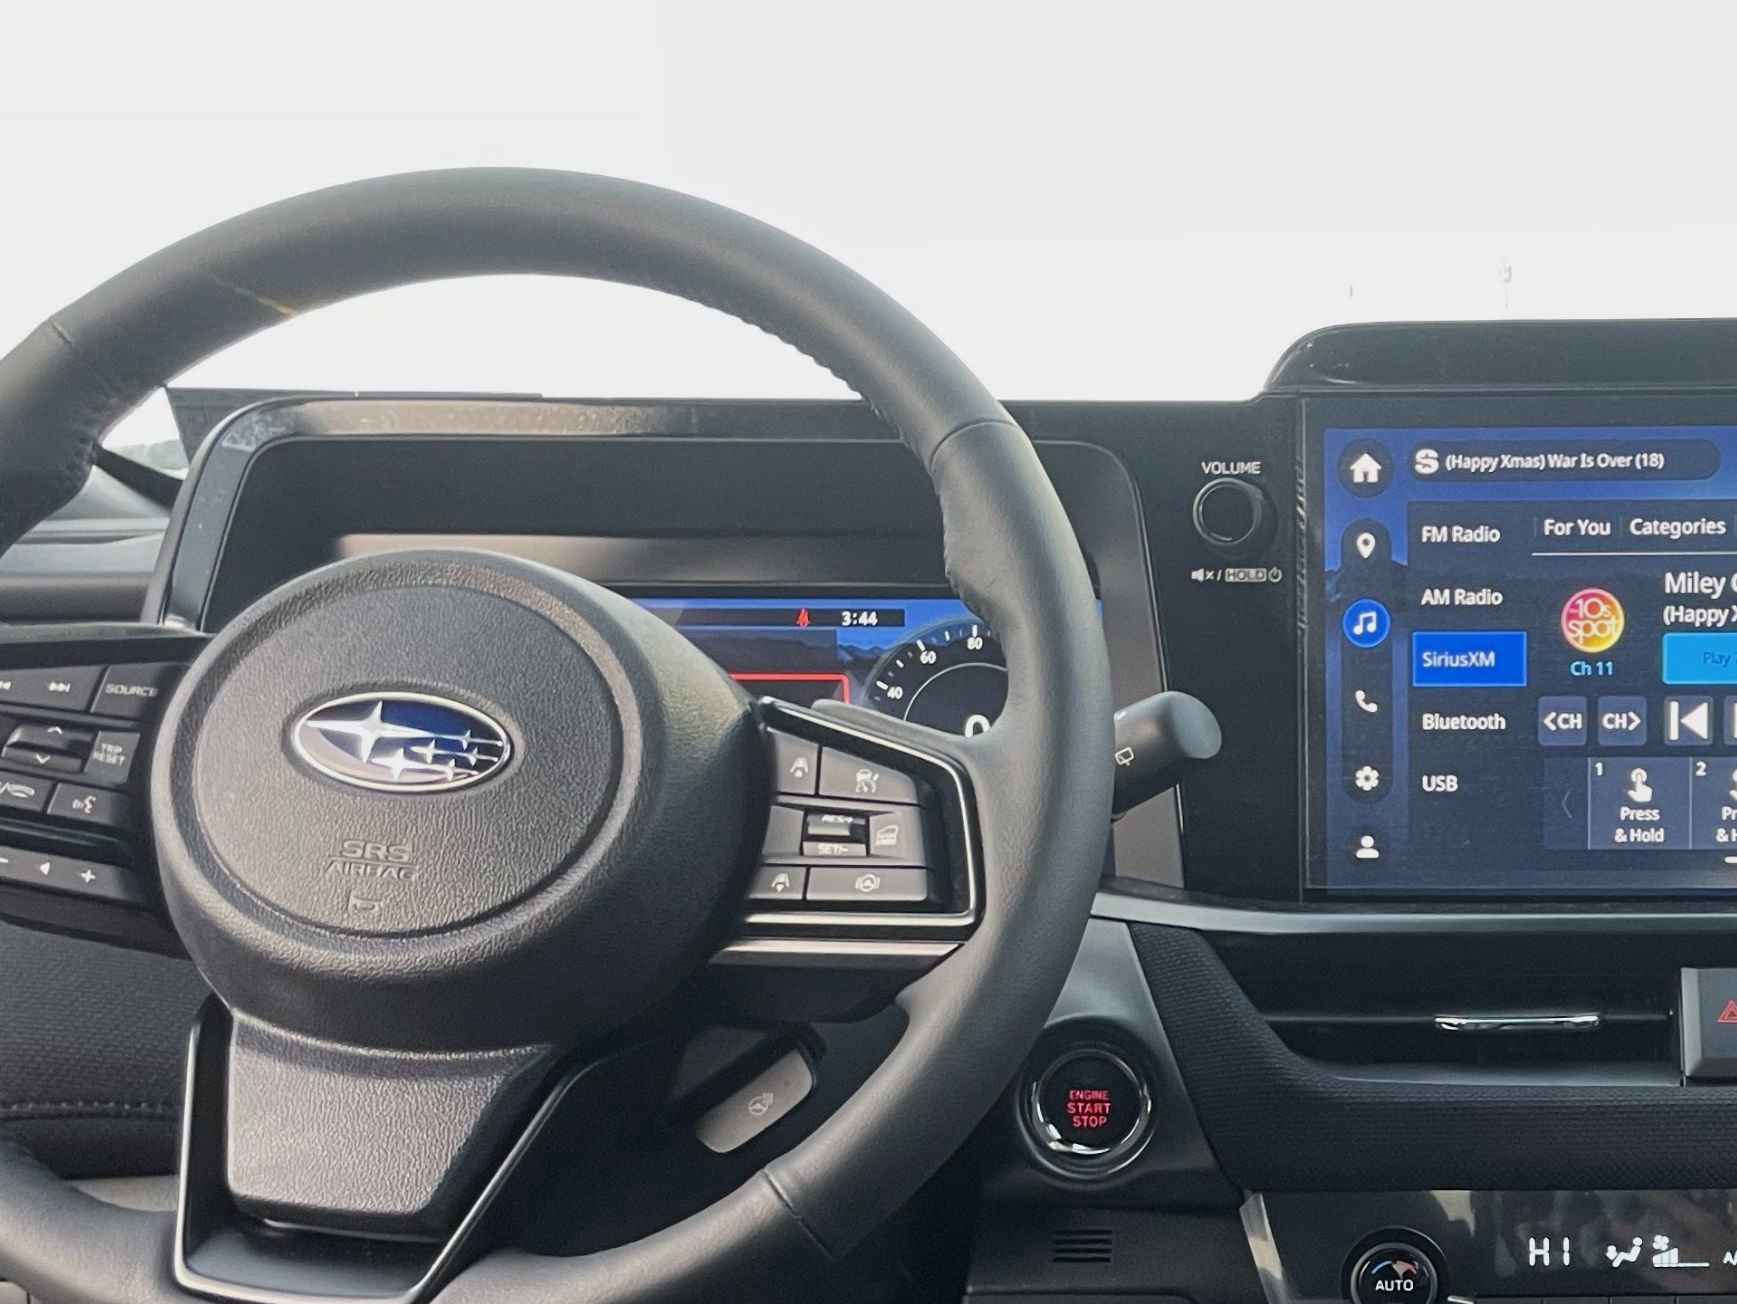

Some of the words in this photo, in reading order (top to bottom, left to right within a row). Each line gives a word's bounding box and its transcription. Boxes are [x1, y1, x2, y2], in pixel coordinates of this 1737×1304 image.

[1201, 461, 1261, 475] VOLUME
[1445, 453, 1498, 472] (Happy
[1500, 453, 1545, 471] Xmas)
[1548, 453, 1576, 468] War
[1580, 453, 1594, 468] Is
[1596, 453, 1633, 468] Over
[1635, 452, 1665, 470] (18)
[1421, 526, 1448, 543] FM
[1451, 525, 1501, 543] Radio
[1543, 519, 1574, 536] For
[1577, 519, 1611, 536] You
[1629, 517, 1727, 539] Categories
[1226, 569, 1266, 581] HOLD
[1664, 571, 1726, 600] Miley
[1421, 588, 1450, 606] AM
[1454, 588, 1504, 605] Radio
[841, 611, 878, 626] 3:44
[1663, 604, 1729, 627] (Happy
[1567, 617, 1619, 644] spot
[967, 637, 983, 650] 80
[920, 651, 936, 664] 60
[1422, 651, 1496, 668] SiriusXM
[1703, 651, 1731, 668] Play
[1570, 660, 1591, 676] Ch
[1596, 661, 1614, 676] 11
[105, 683, 159, 697] SOURCE
[887, 687, 903, 700] 40
[1421, 712, 1506, 731] Bluetooth
[1595, 762, 1604, 777] 1
[1695, 762, 1706, 777] 2
[1421, 775, 1458, 792] USB
[1620, 806, 1660, 822] Press
[1614, 829, 1627, 843] &
[1630, 827, 1665, 843] Hold
[1716, 829, 1728, 843] &
[342, 840, 409, 862] SRS
[1069, 1090, 1109, 1100] ENGINE
[1067, 1102, 1111, 1114] START
[1073, 1115, 1107, 1128] STOP
[1375, 1279, 1414, 1292] AUTO
